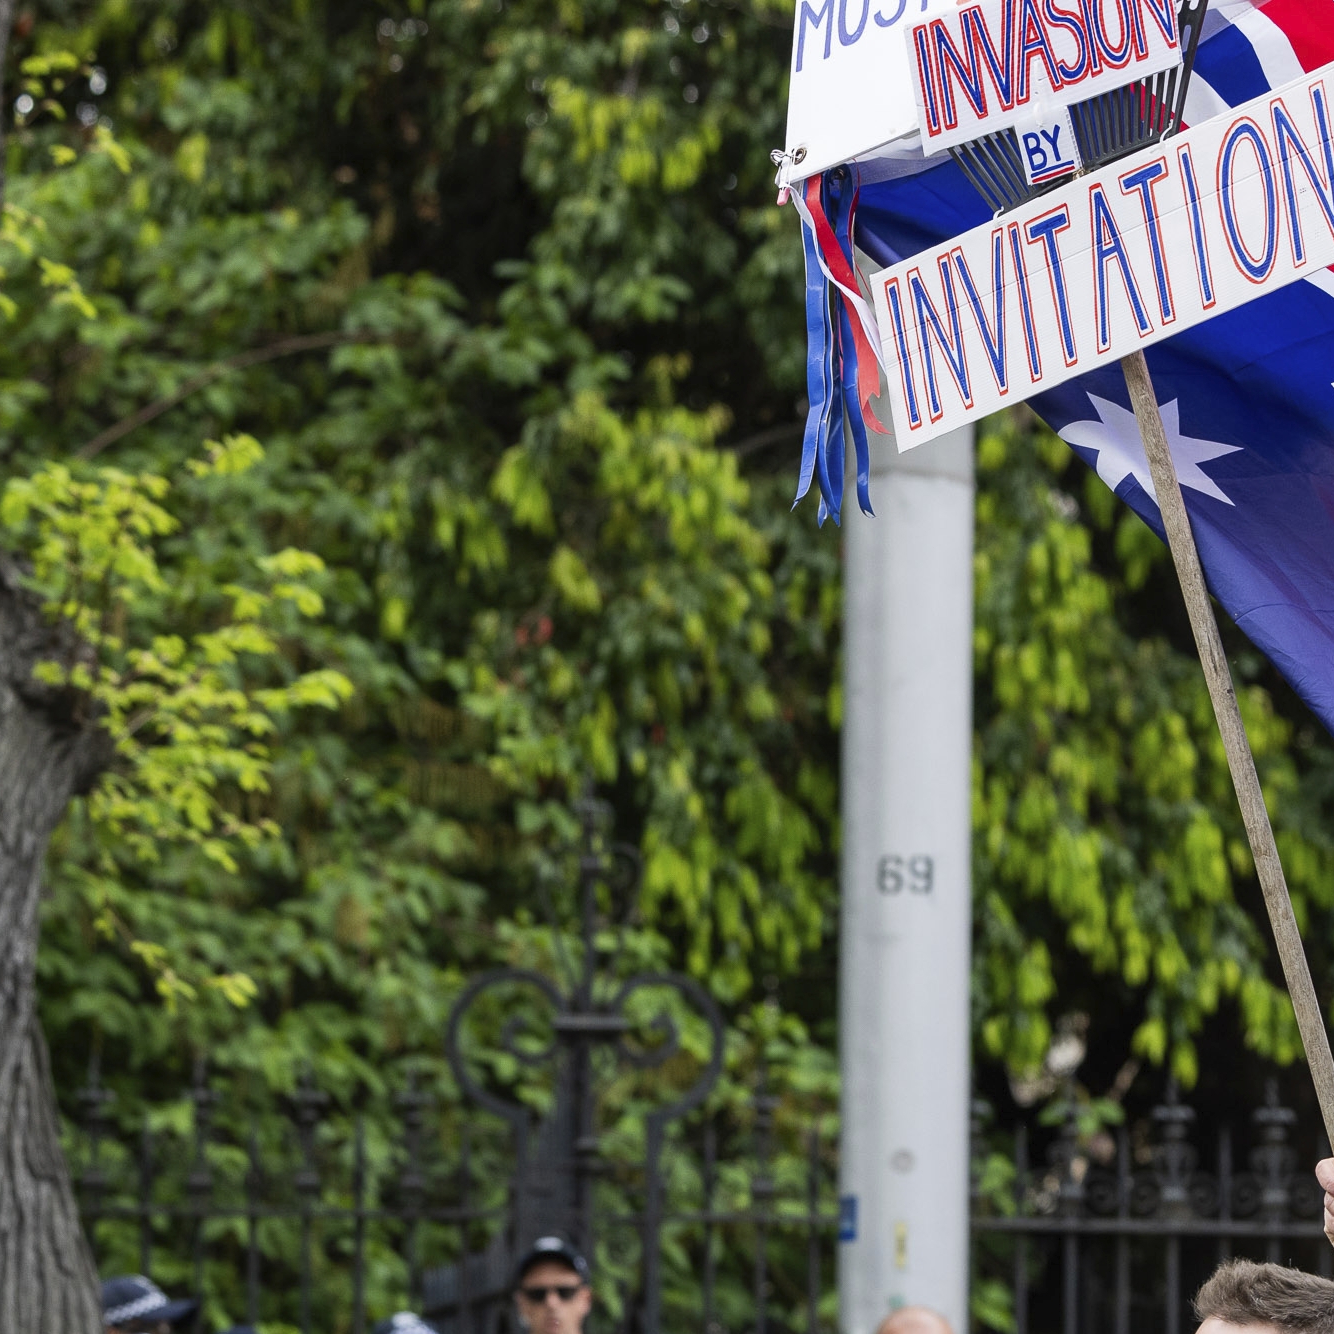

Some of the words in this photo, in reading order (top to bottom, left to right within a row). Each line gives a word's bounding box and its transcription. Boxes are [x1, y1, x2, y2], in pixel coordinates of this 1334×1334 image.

[913, 0, 1178, 137] INVASION
[1023, 125, 1061, 171] BY
[876, 854, 934, 895] 69
